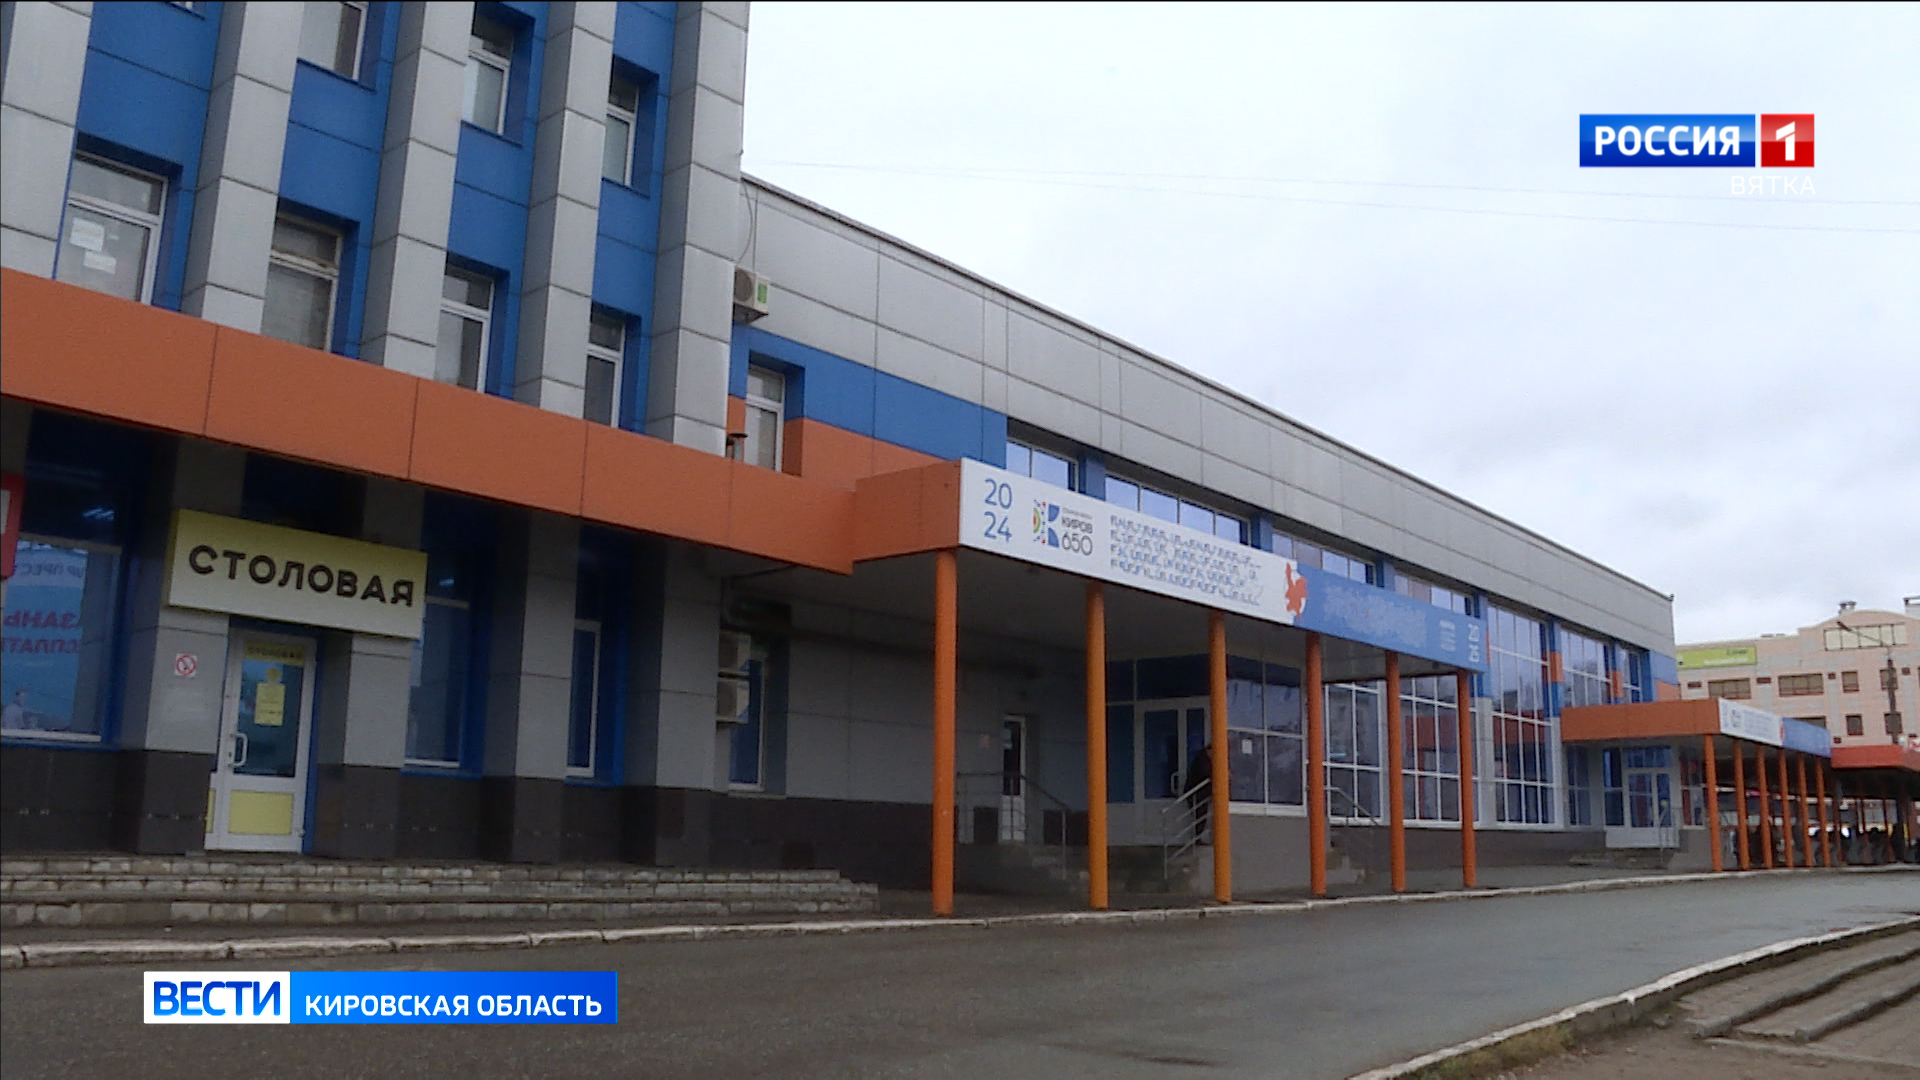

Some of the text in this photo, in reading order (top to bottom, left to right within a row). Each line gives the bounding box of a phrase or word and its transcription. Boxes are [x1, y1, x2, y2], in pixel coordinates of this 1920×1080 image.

[985, 477, 1013, 510] 20
[984, 511, 1013, 543] 24
[1061, 515, 1094, 534] КИРОВ
[1061, 532, 1093, 556] 650
[189, 544, 415, 607] СТОЛОВАЯ
